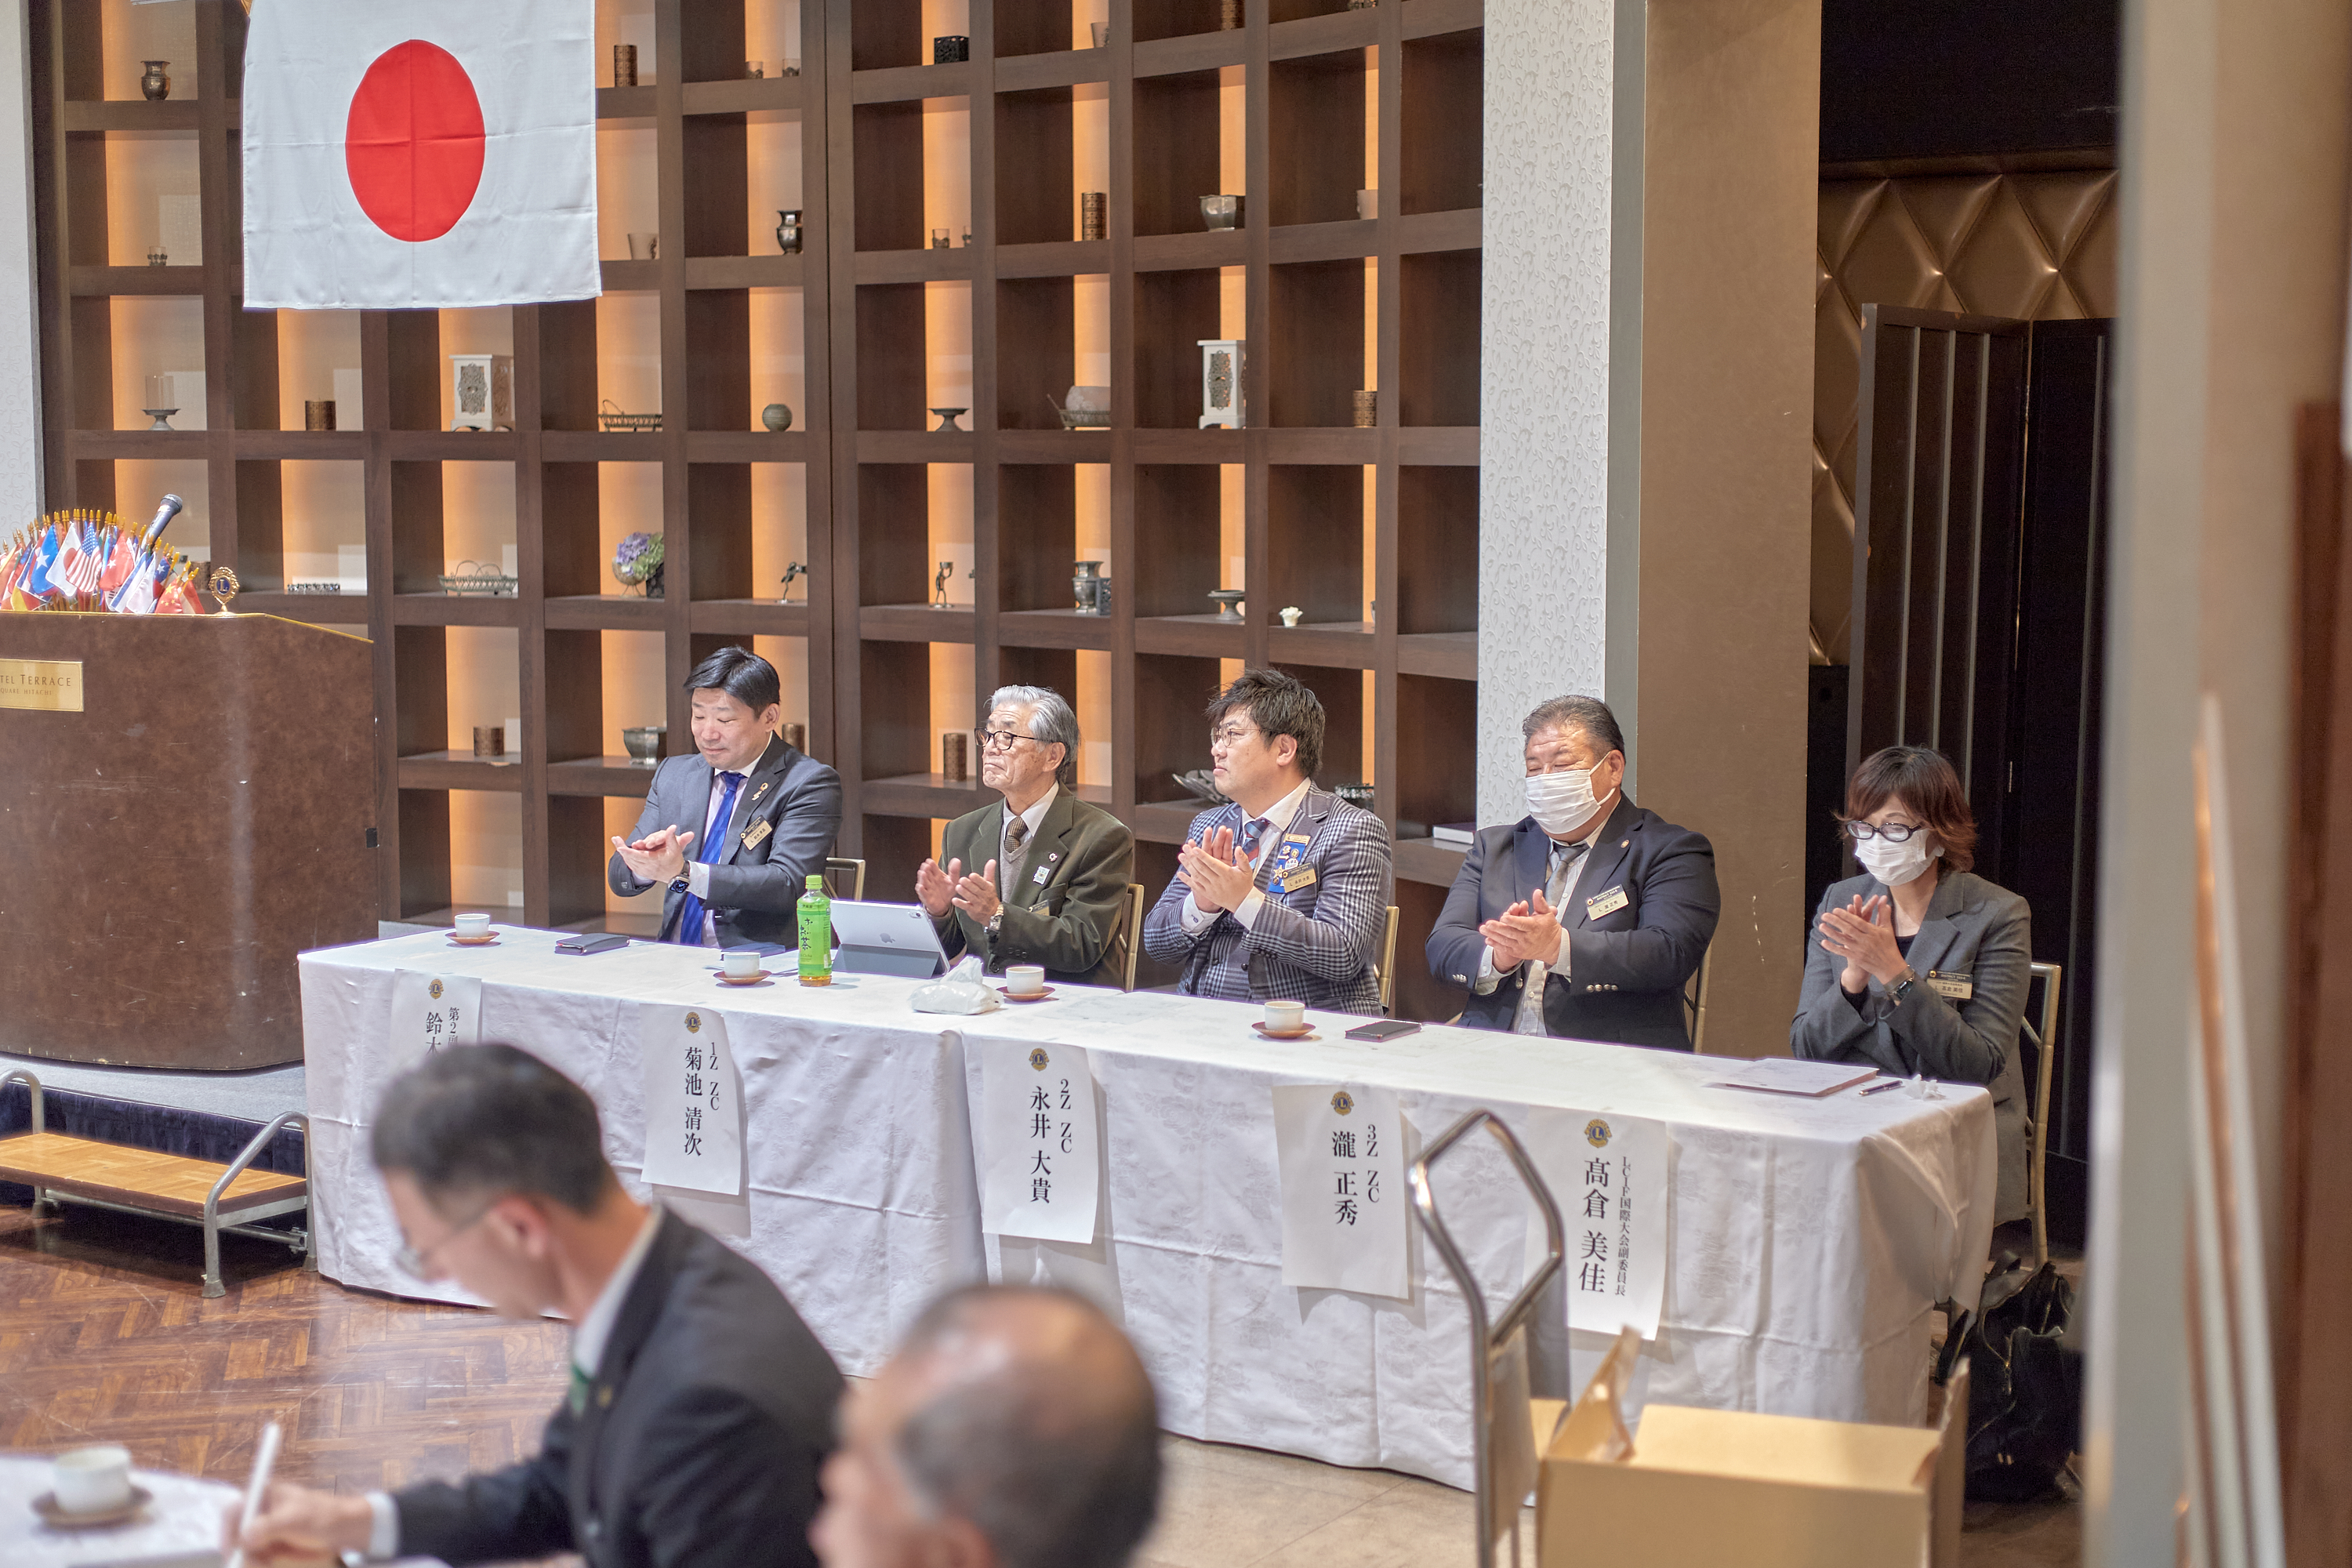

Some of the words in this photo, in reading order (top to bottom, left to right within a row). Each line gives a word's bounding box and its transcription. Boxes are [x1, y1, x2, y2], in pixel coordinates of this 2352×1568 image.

[20, 674, 71, 687] TERRACE
[684, 1046, 702, 1097] 菊池
[709, 1041, 718, 1071] 1Z
[709, 1081, 720, 1111] ZC
[1060, 1078, 1071, 1109] 2Z
[1029, 1085, 1051, 1139] 永井
[684, 1106, 702, 1157] 清次
[1060, 1122, 1072, 1154] ZC
[1331, 1130, 1357, 1159] 瀧
[1367, 1123, 1378, 1157] 3Z
[1029, 1149, 1051, 1204] 大貴
[1367, 1169, 1380, 1203] ZC
[1334, 1171, 1359, 1226] 正秀
[1578, 1229, 1609, 1294] 美佳
